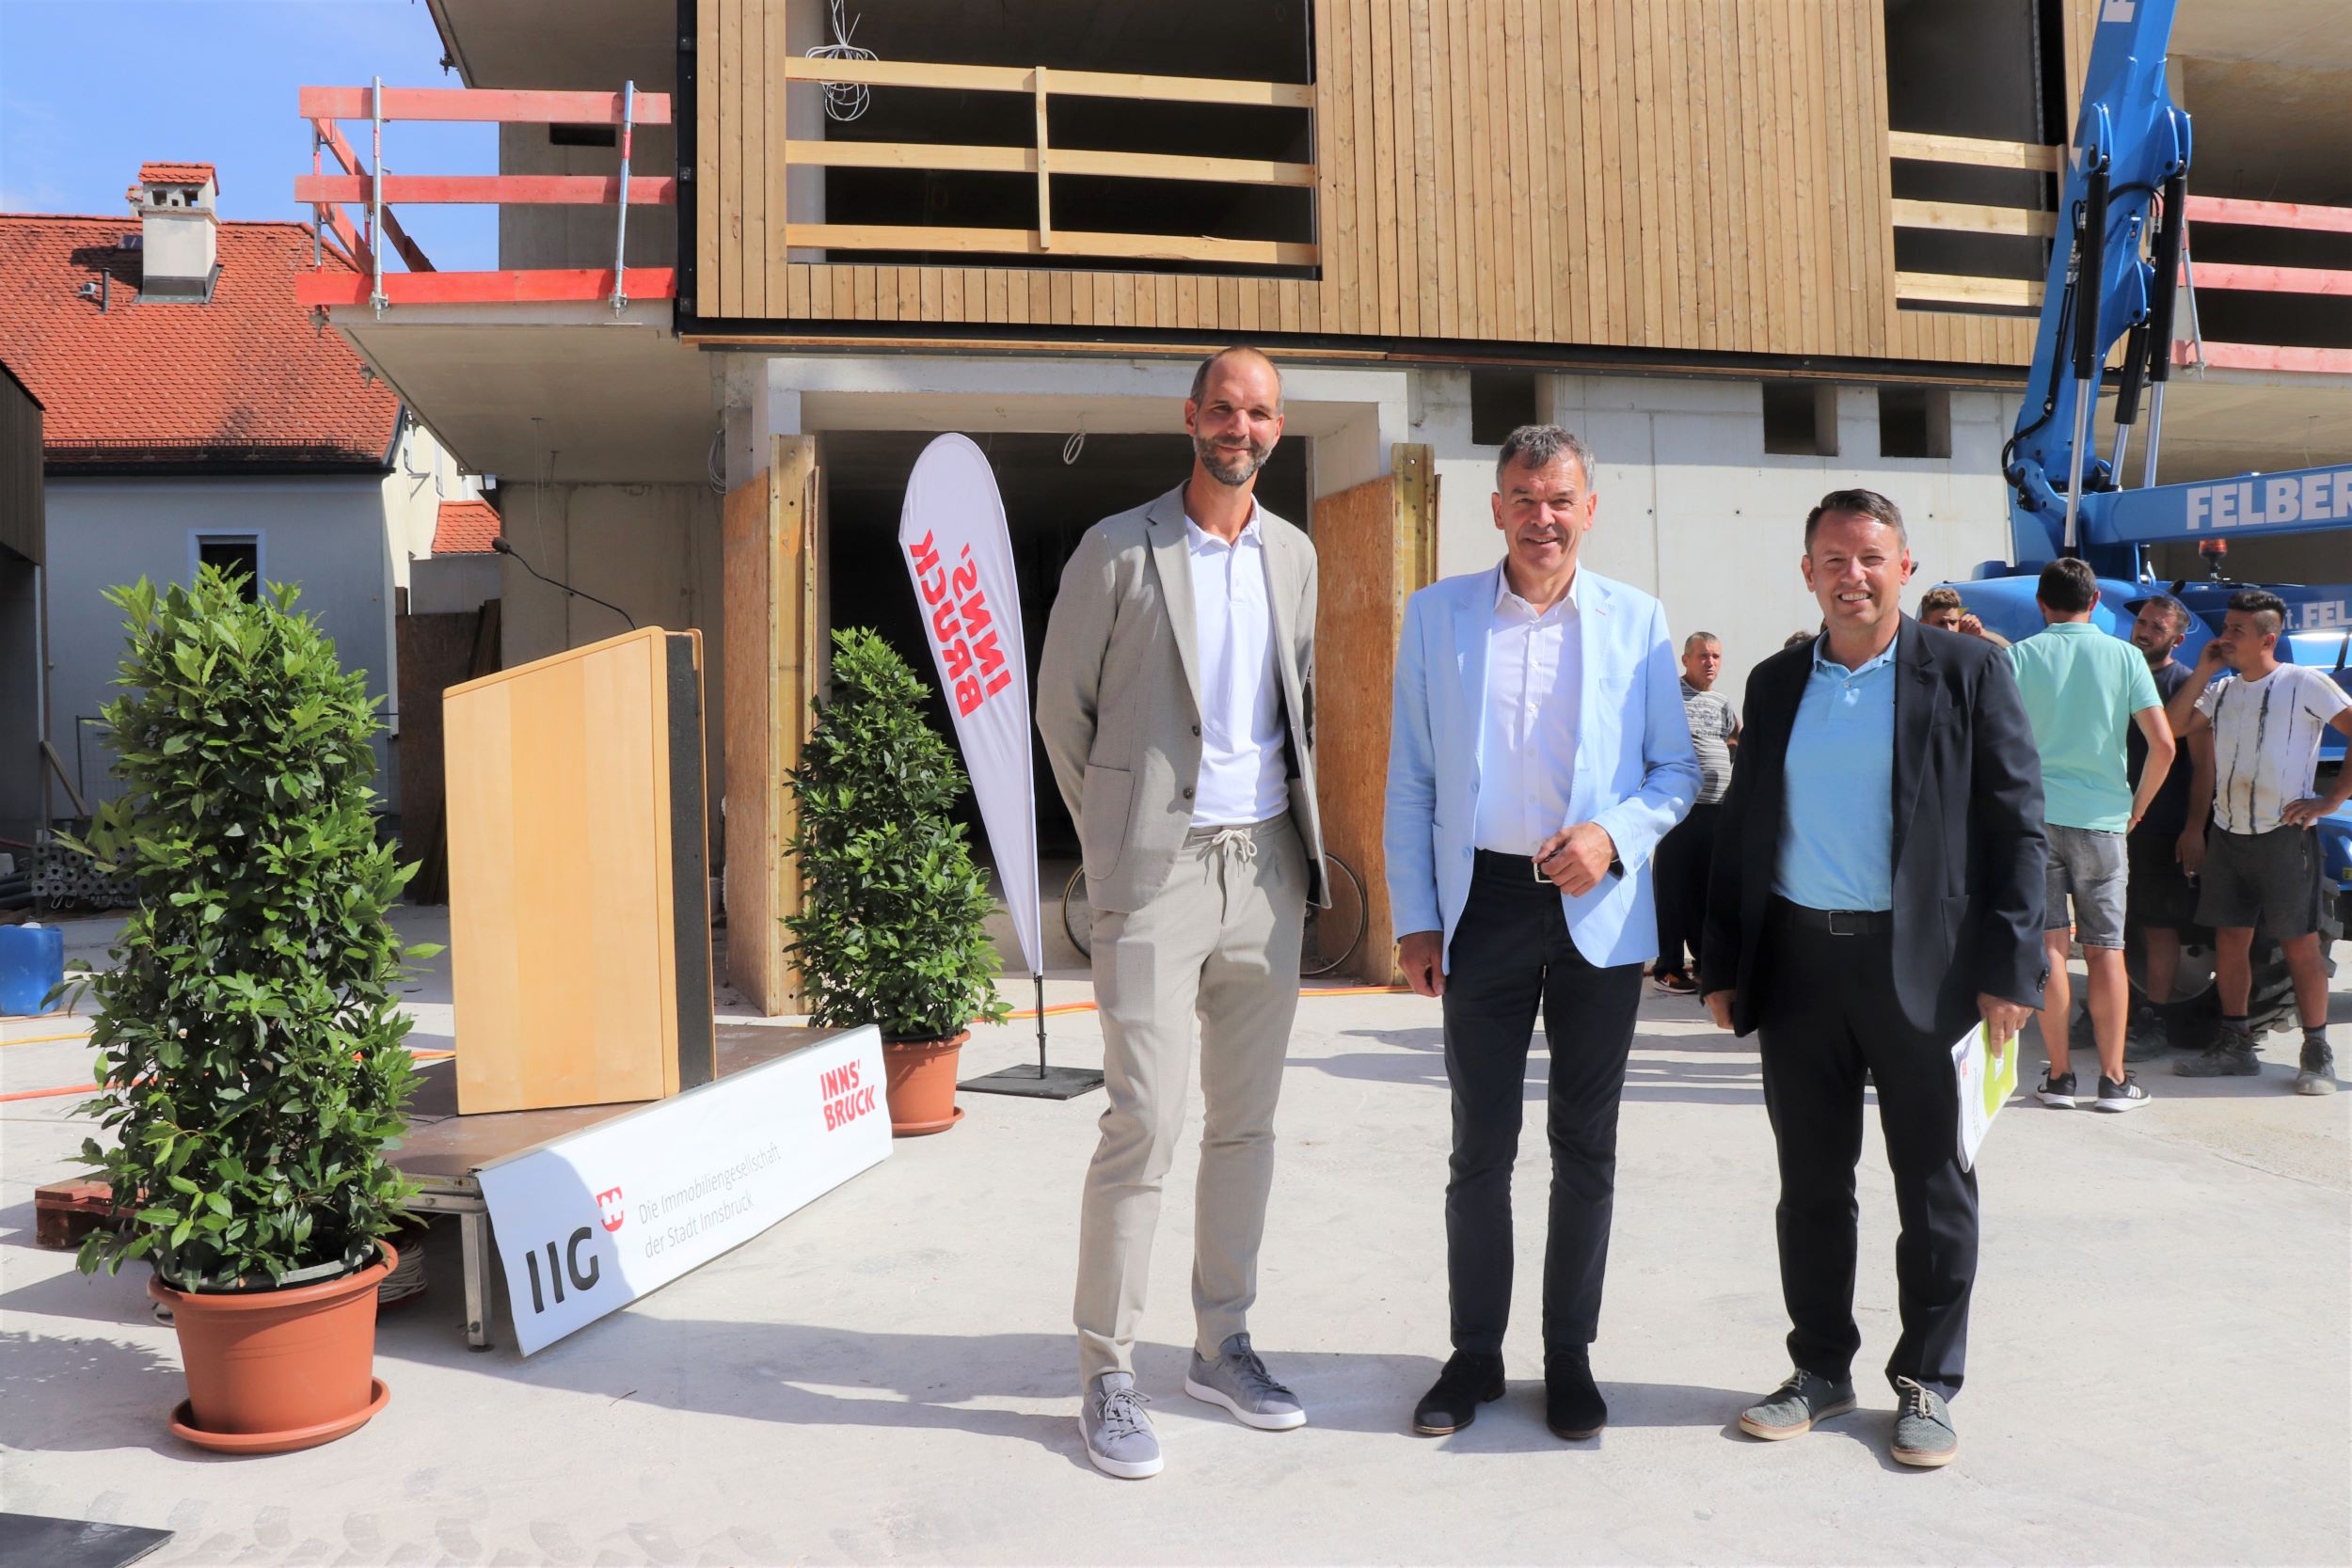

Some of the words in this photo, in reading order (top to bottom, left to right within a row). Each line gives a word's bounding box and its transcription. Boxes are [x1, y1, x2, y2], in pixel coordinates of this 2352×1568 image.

[820, 1058, 860, 1101] INNS'
[823, 1084, 876, 1132] BRUCK
[638, 1199, 660, 1225] Die
[660, 1141, 782, 1214] Immobiliengesellschaft
[645, 1234, 665, 1259] der
[667, 1216, 698, 1247] Stadt
[699, 1190, 754, 1232] Innsbruck
